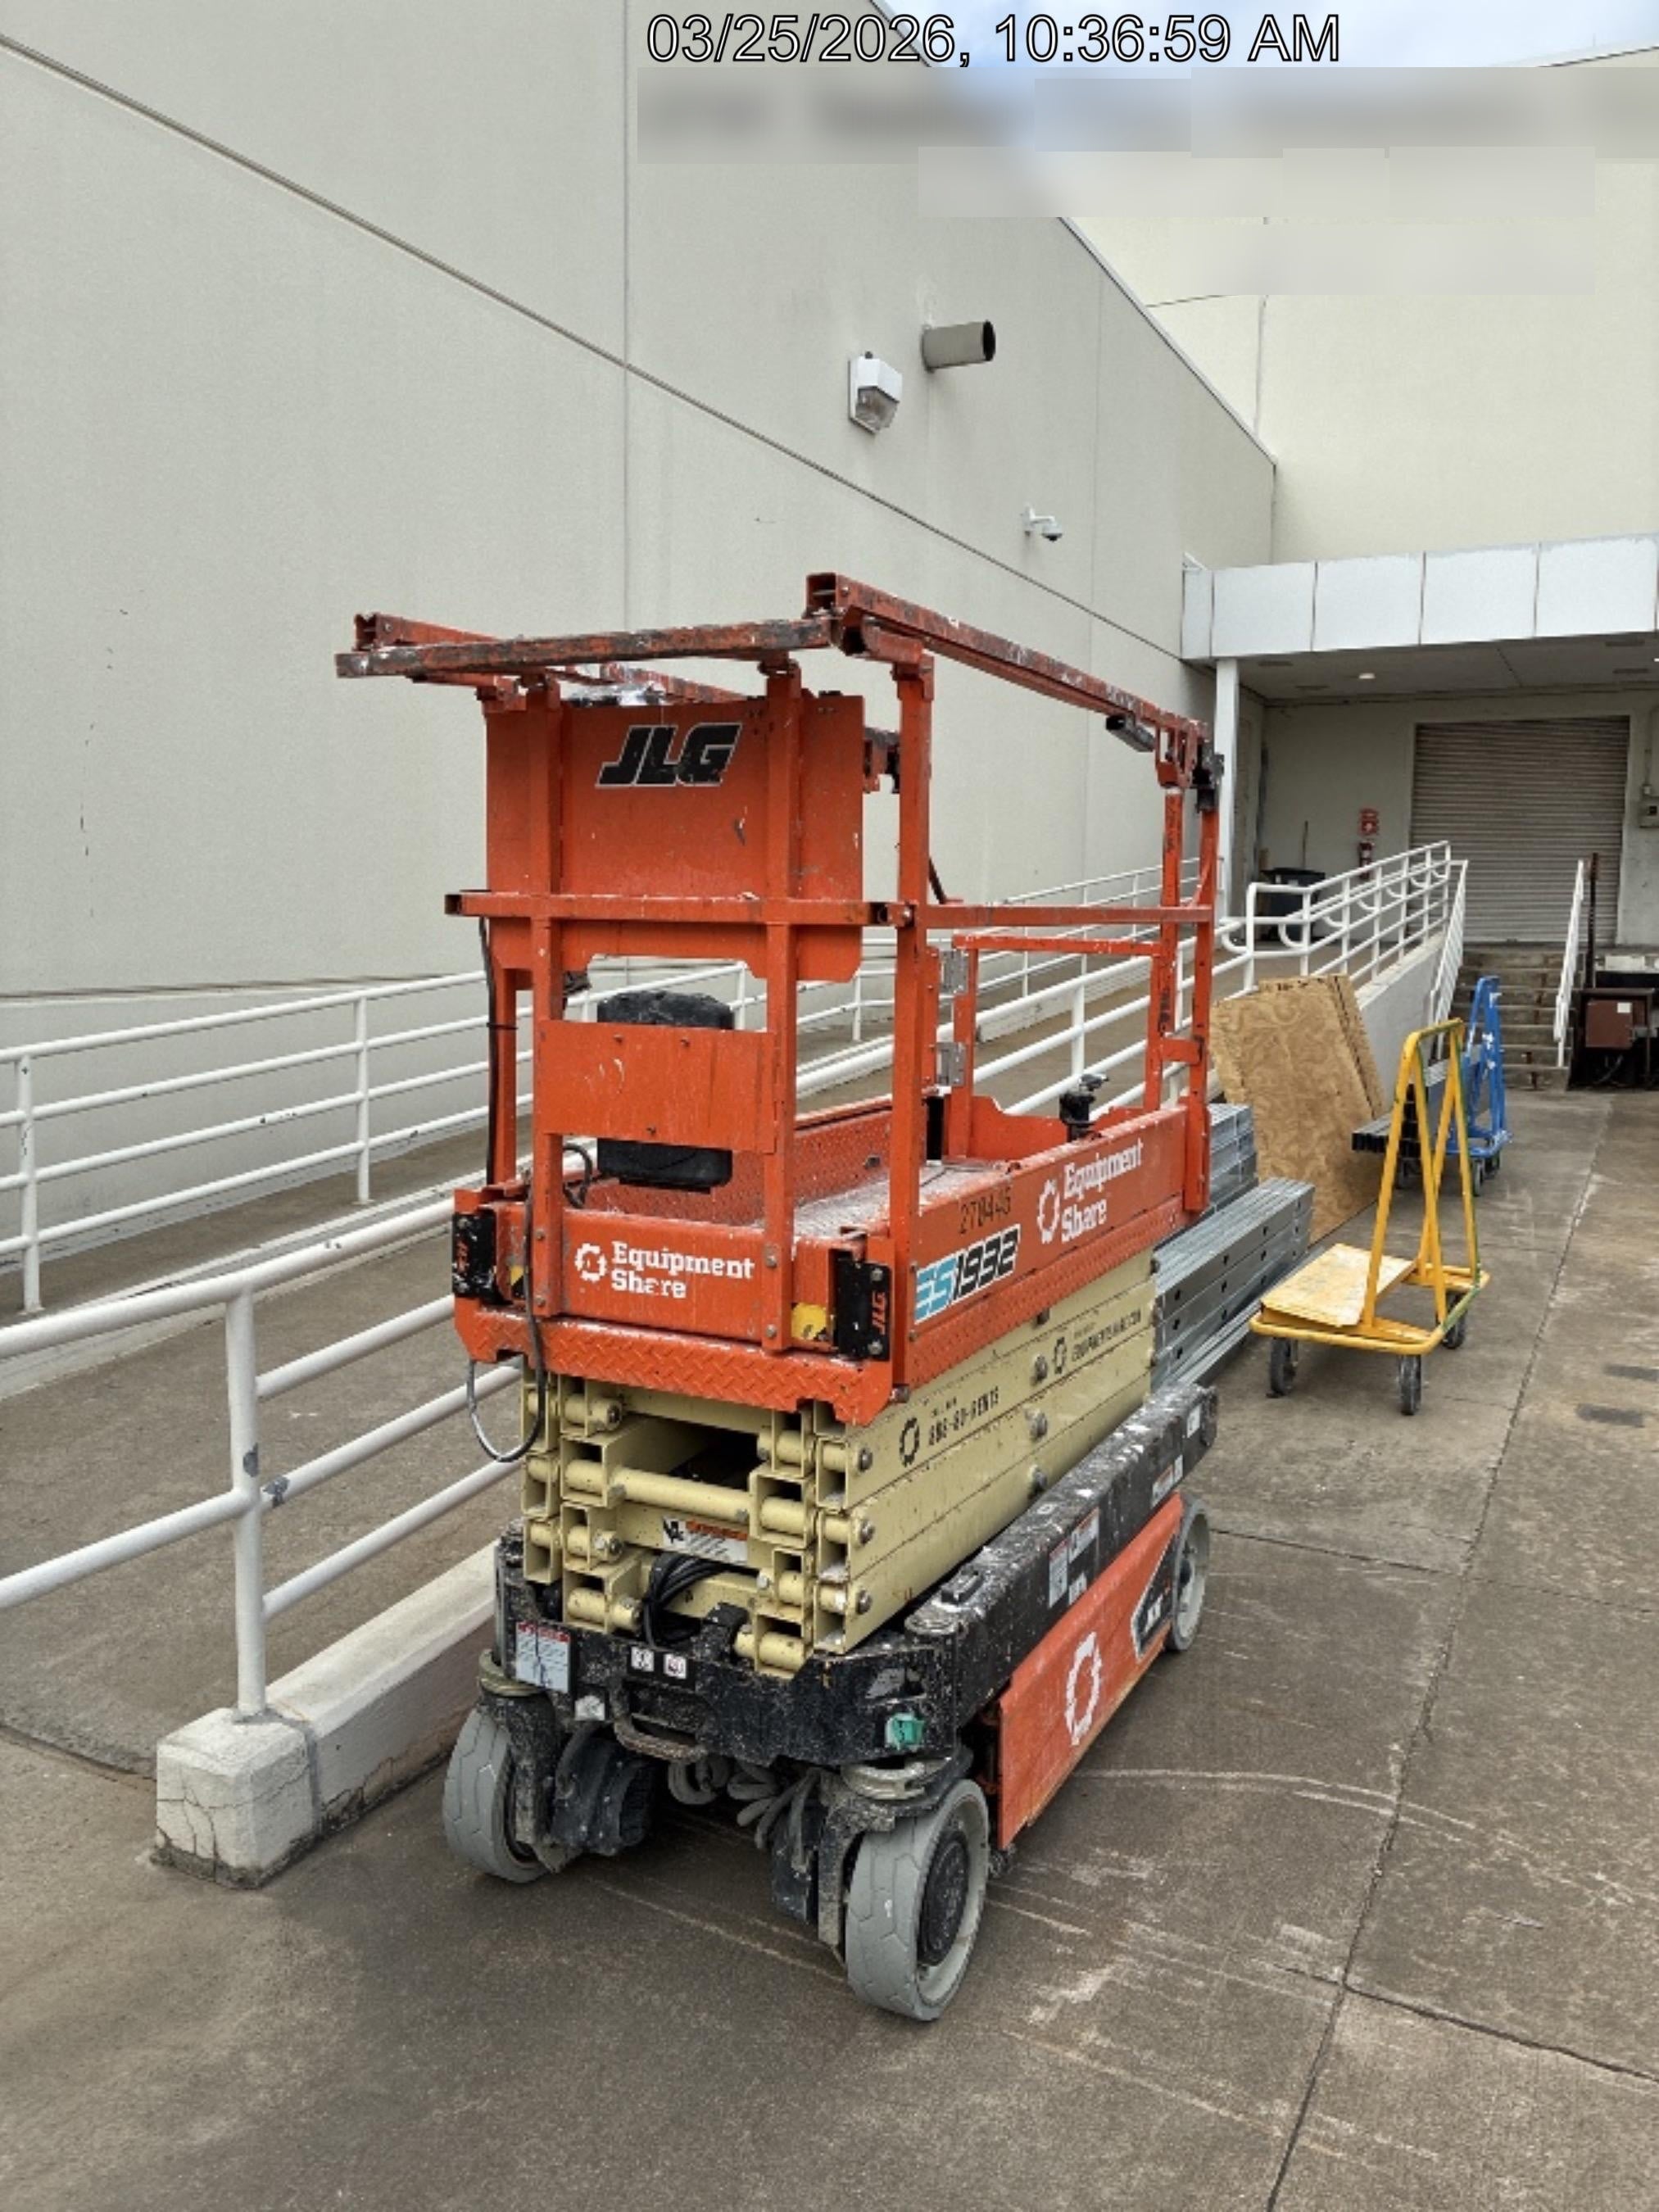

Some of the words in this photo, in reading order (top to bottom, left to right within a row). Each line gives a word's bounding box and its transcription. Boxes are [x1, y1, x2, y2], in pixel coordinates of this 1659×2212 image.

[595, 722, 742, 787] JLG
[1063, 1137, 1144, 1200] Equipment
[1062, 1199, 1108, 1242] Share
[611, 1240, 755, 1280] Equipment
[611, 1267, 687, 1299] Share
[914, 1223, 1021, 1326] ES1932
